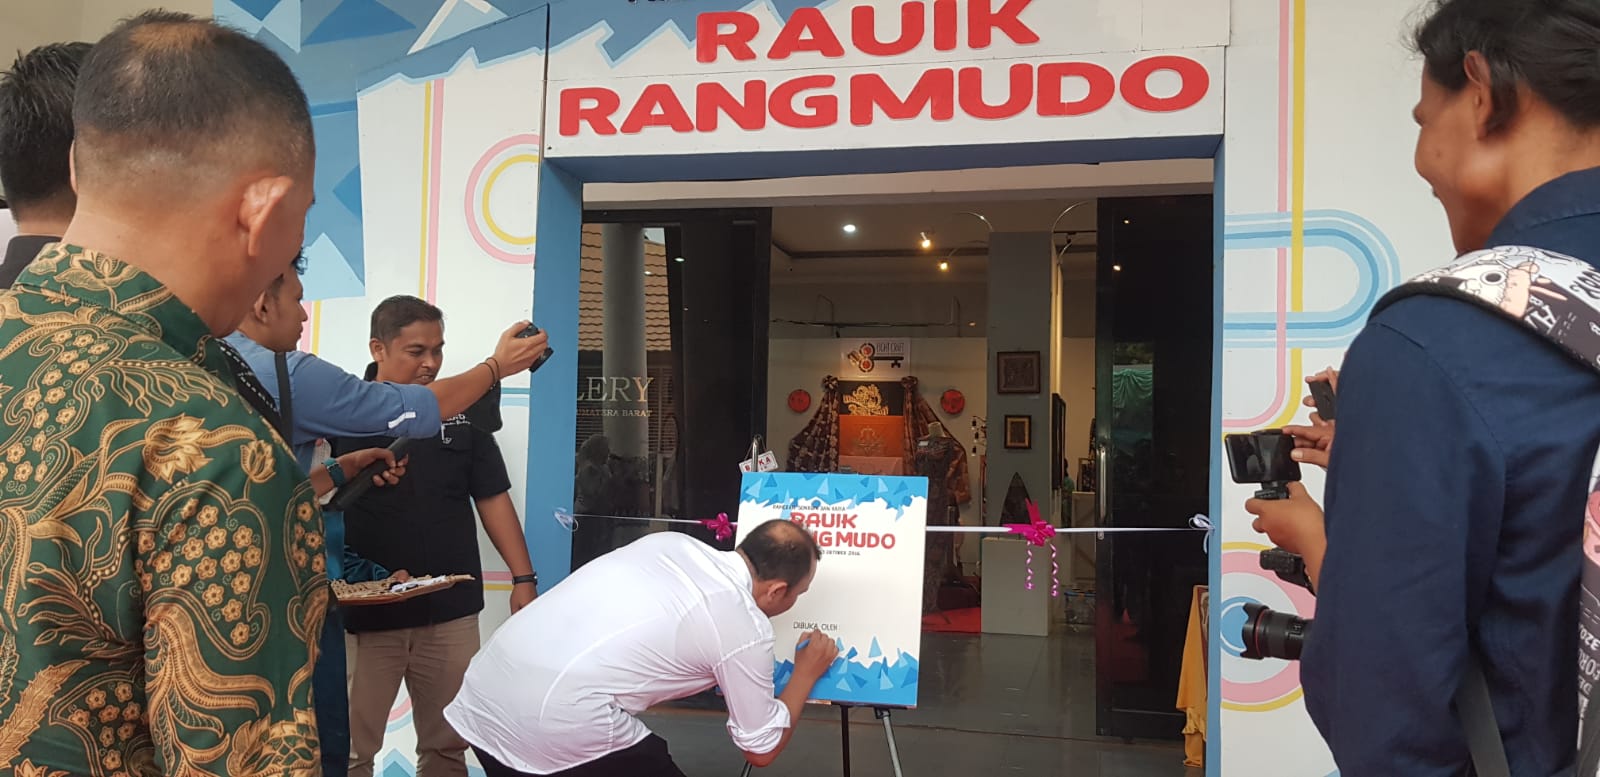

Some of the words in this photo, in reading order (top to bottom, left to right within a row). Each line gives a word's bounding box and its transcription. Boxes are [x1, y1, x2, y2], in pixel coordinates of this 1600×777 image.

[696, 0, 1040, 63] RAUIK
[559, 75, 838, 136] RANG
[850, 55, 1210, 126] MUDO
[577, 376, 654, 402] ERY
[790, 511, 858, 529] RAUIK
[835, 531, 896, 550] MUDO
[821, 623, 838, 631] OLEH
